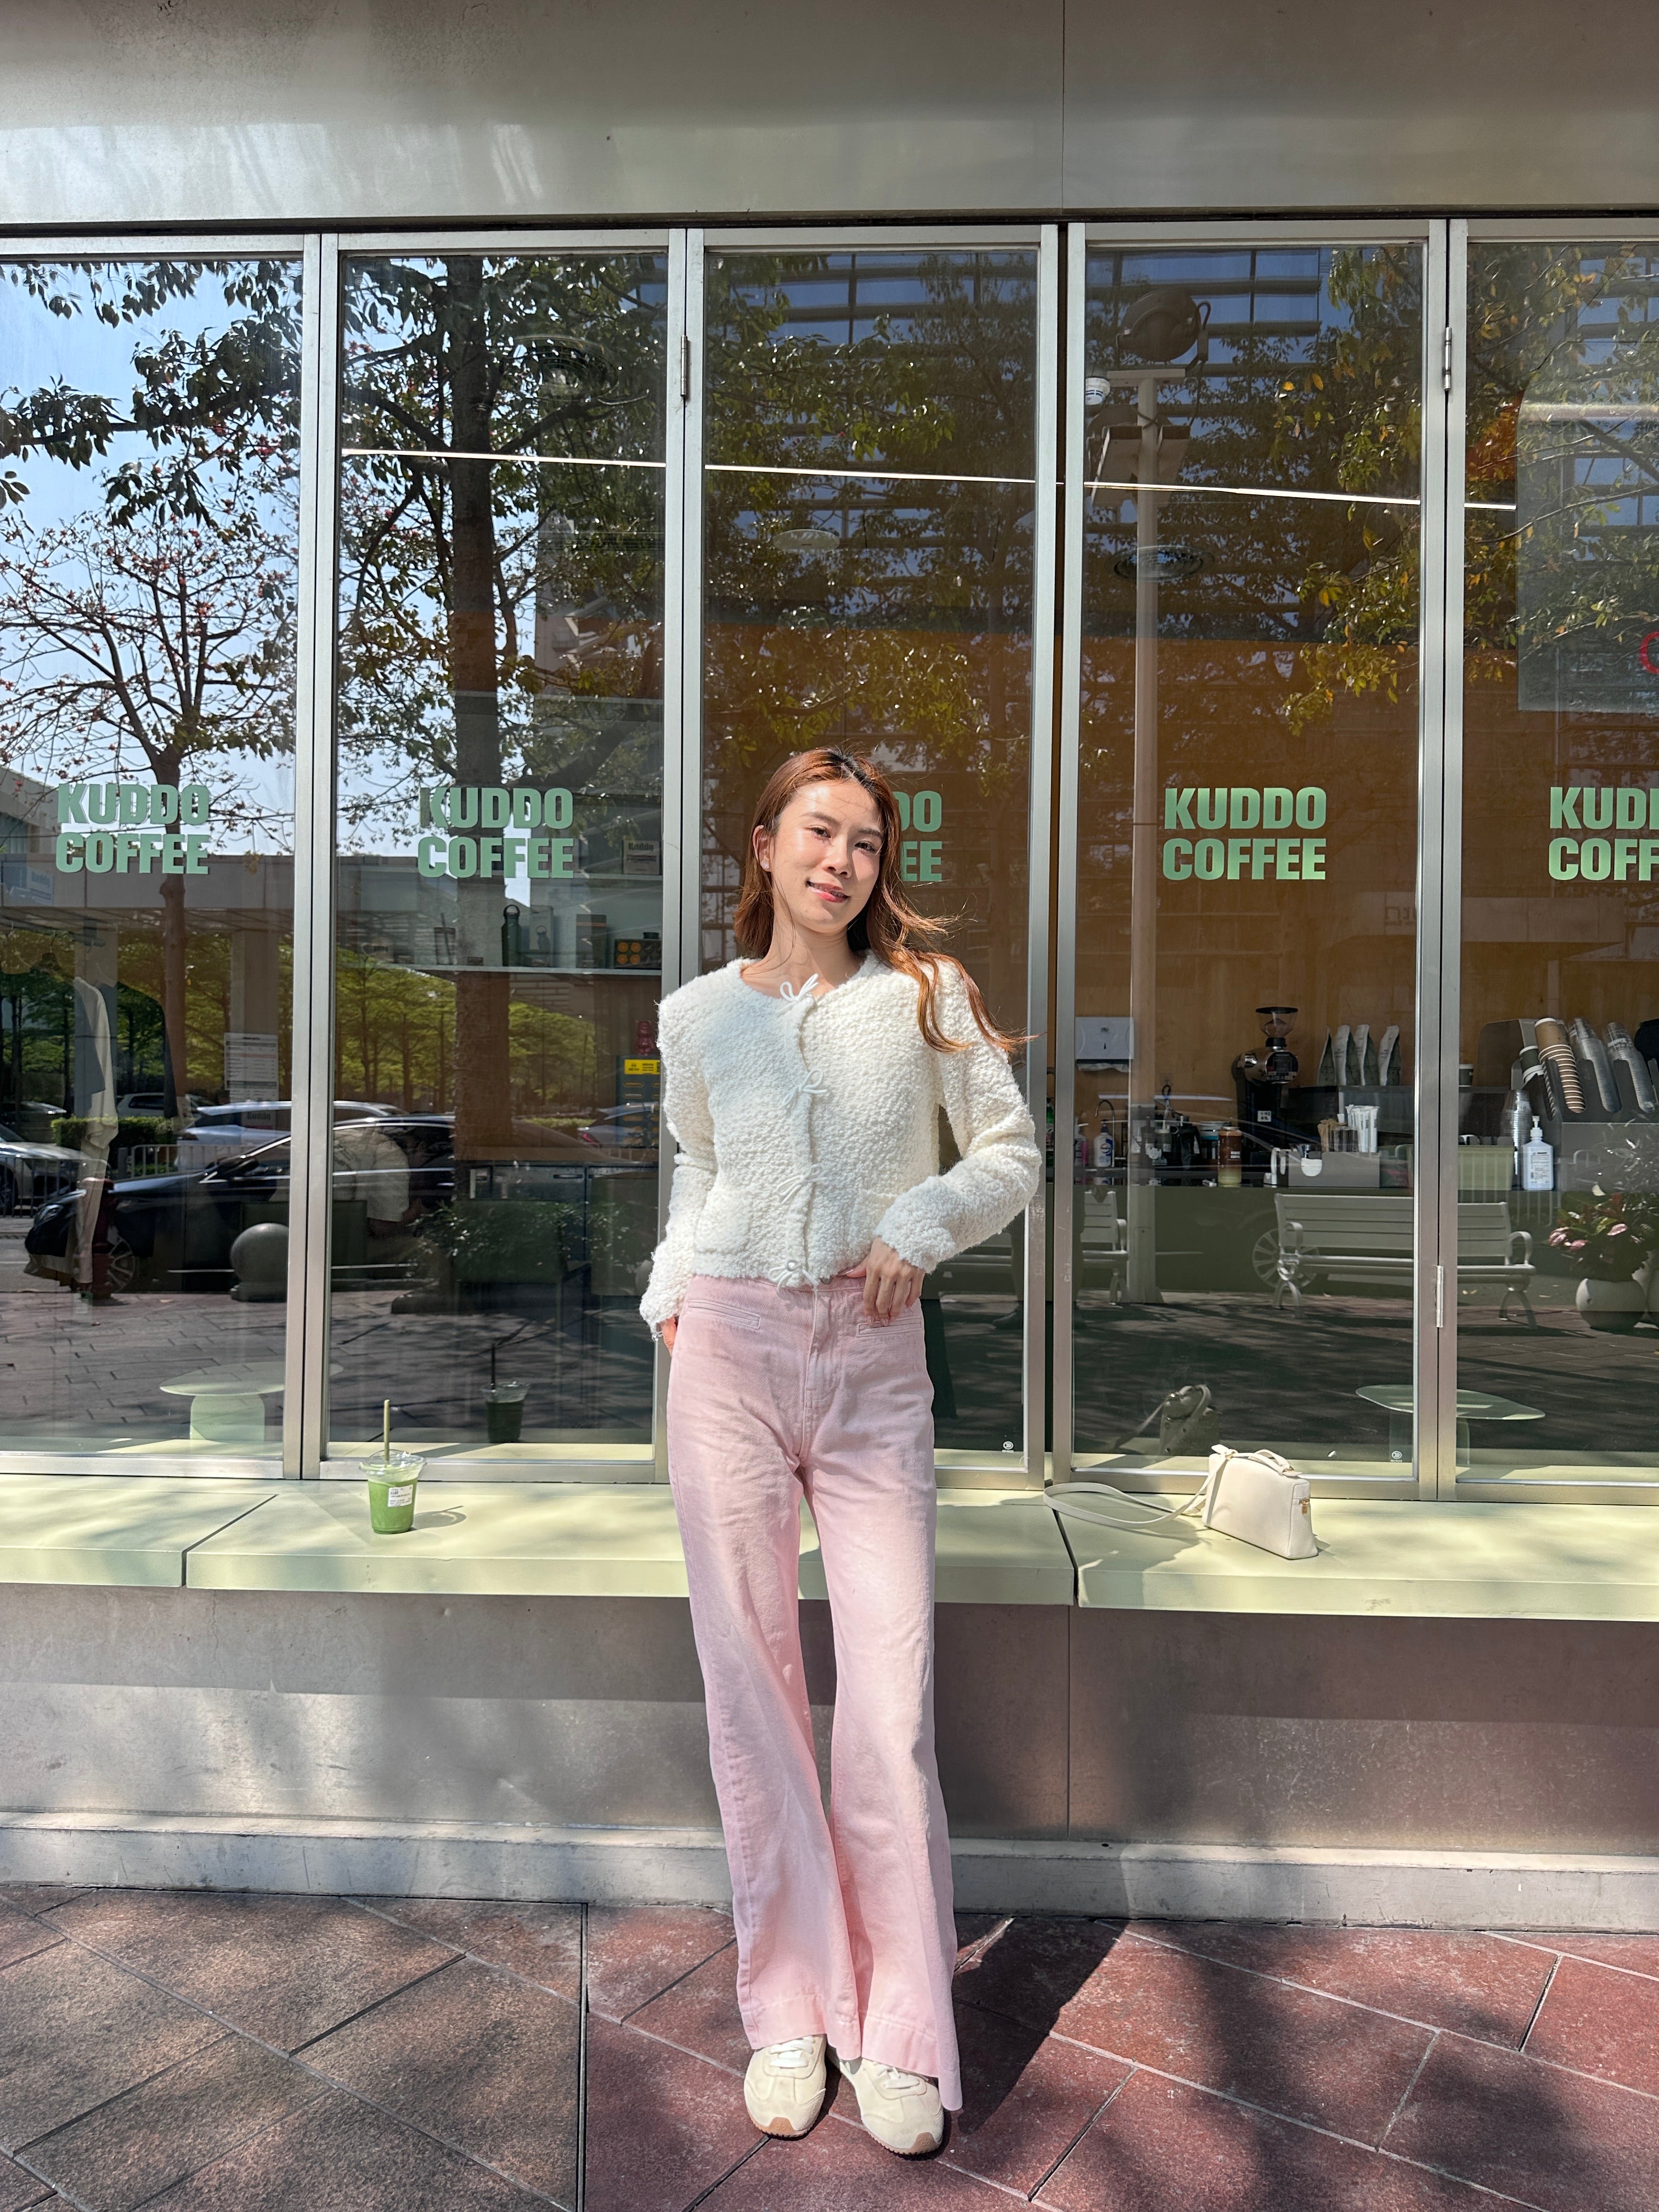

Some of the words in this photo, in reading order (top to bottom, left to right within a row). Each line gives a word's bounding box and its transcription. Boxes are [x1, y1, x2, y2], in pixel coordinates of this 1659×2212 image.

[58, 783, 210, 825] KUDDO
[419, 787, 573, 829] KUDDO
[1164, 787, 1327, 830] KUDDO
[55, 832, 209, 874] COFFEE
[417, 836, 574, 878] COFFEE
[1162, 838, 1327, 881] COFFEE
